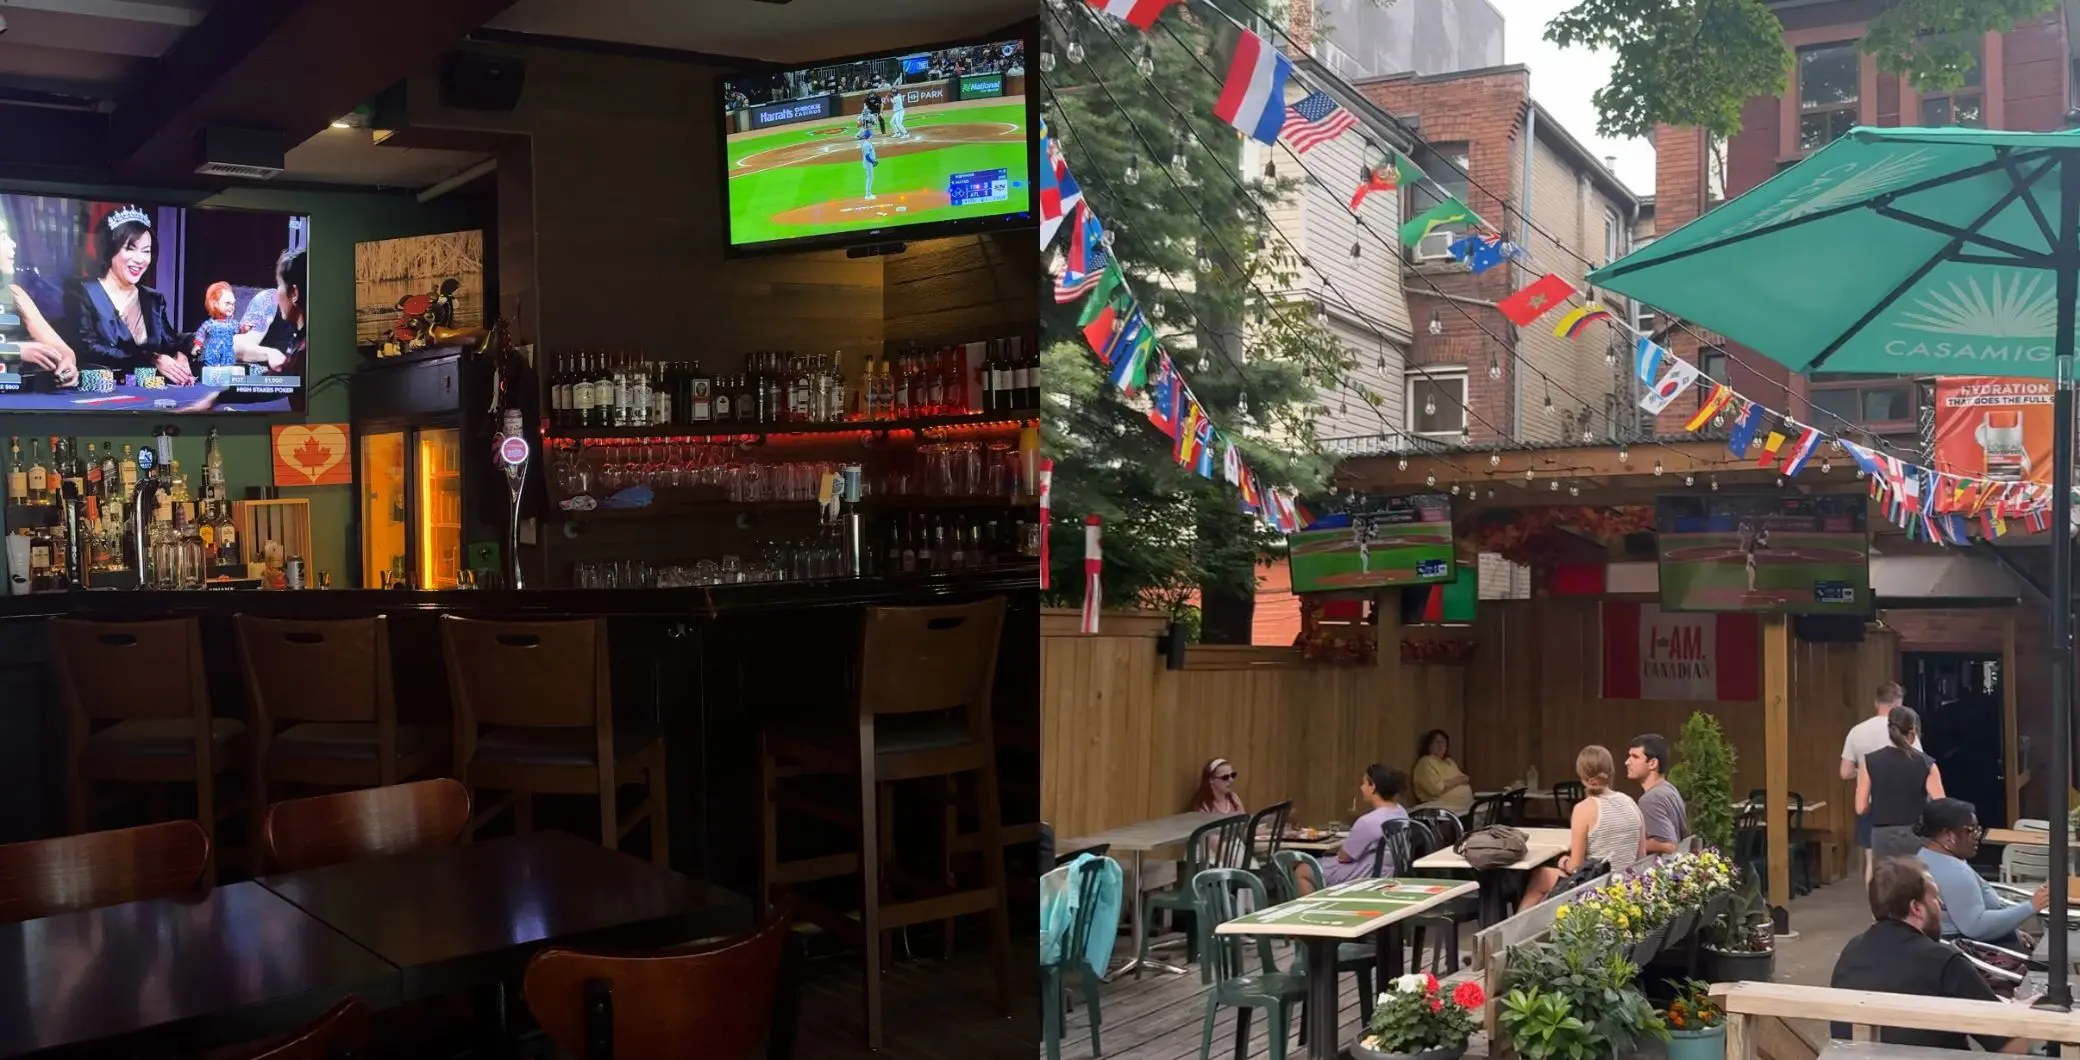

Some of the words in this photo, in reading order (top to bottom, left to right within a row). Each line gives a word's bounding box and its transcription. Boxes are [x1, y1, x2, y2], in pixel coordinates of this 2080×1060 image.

[970, 81, 1000, 91] National
[921, 90, 943, 99] PARK
[794, 109, 821, 117] CASINOS
[1884, 340, 2080, 362] CASAMIG
[1961, 383, 2049, 395] HYDRATION
[1974, 397, 1999, 405] GOES
[1644, 661, 1710, 679] CANADIAN
